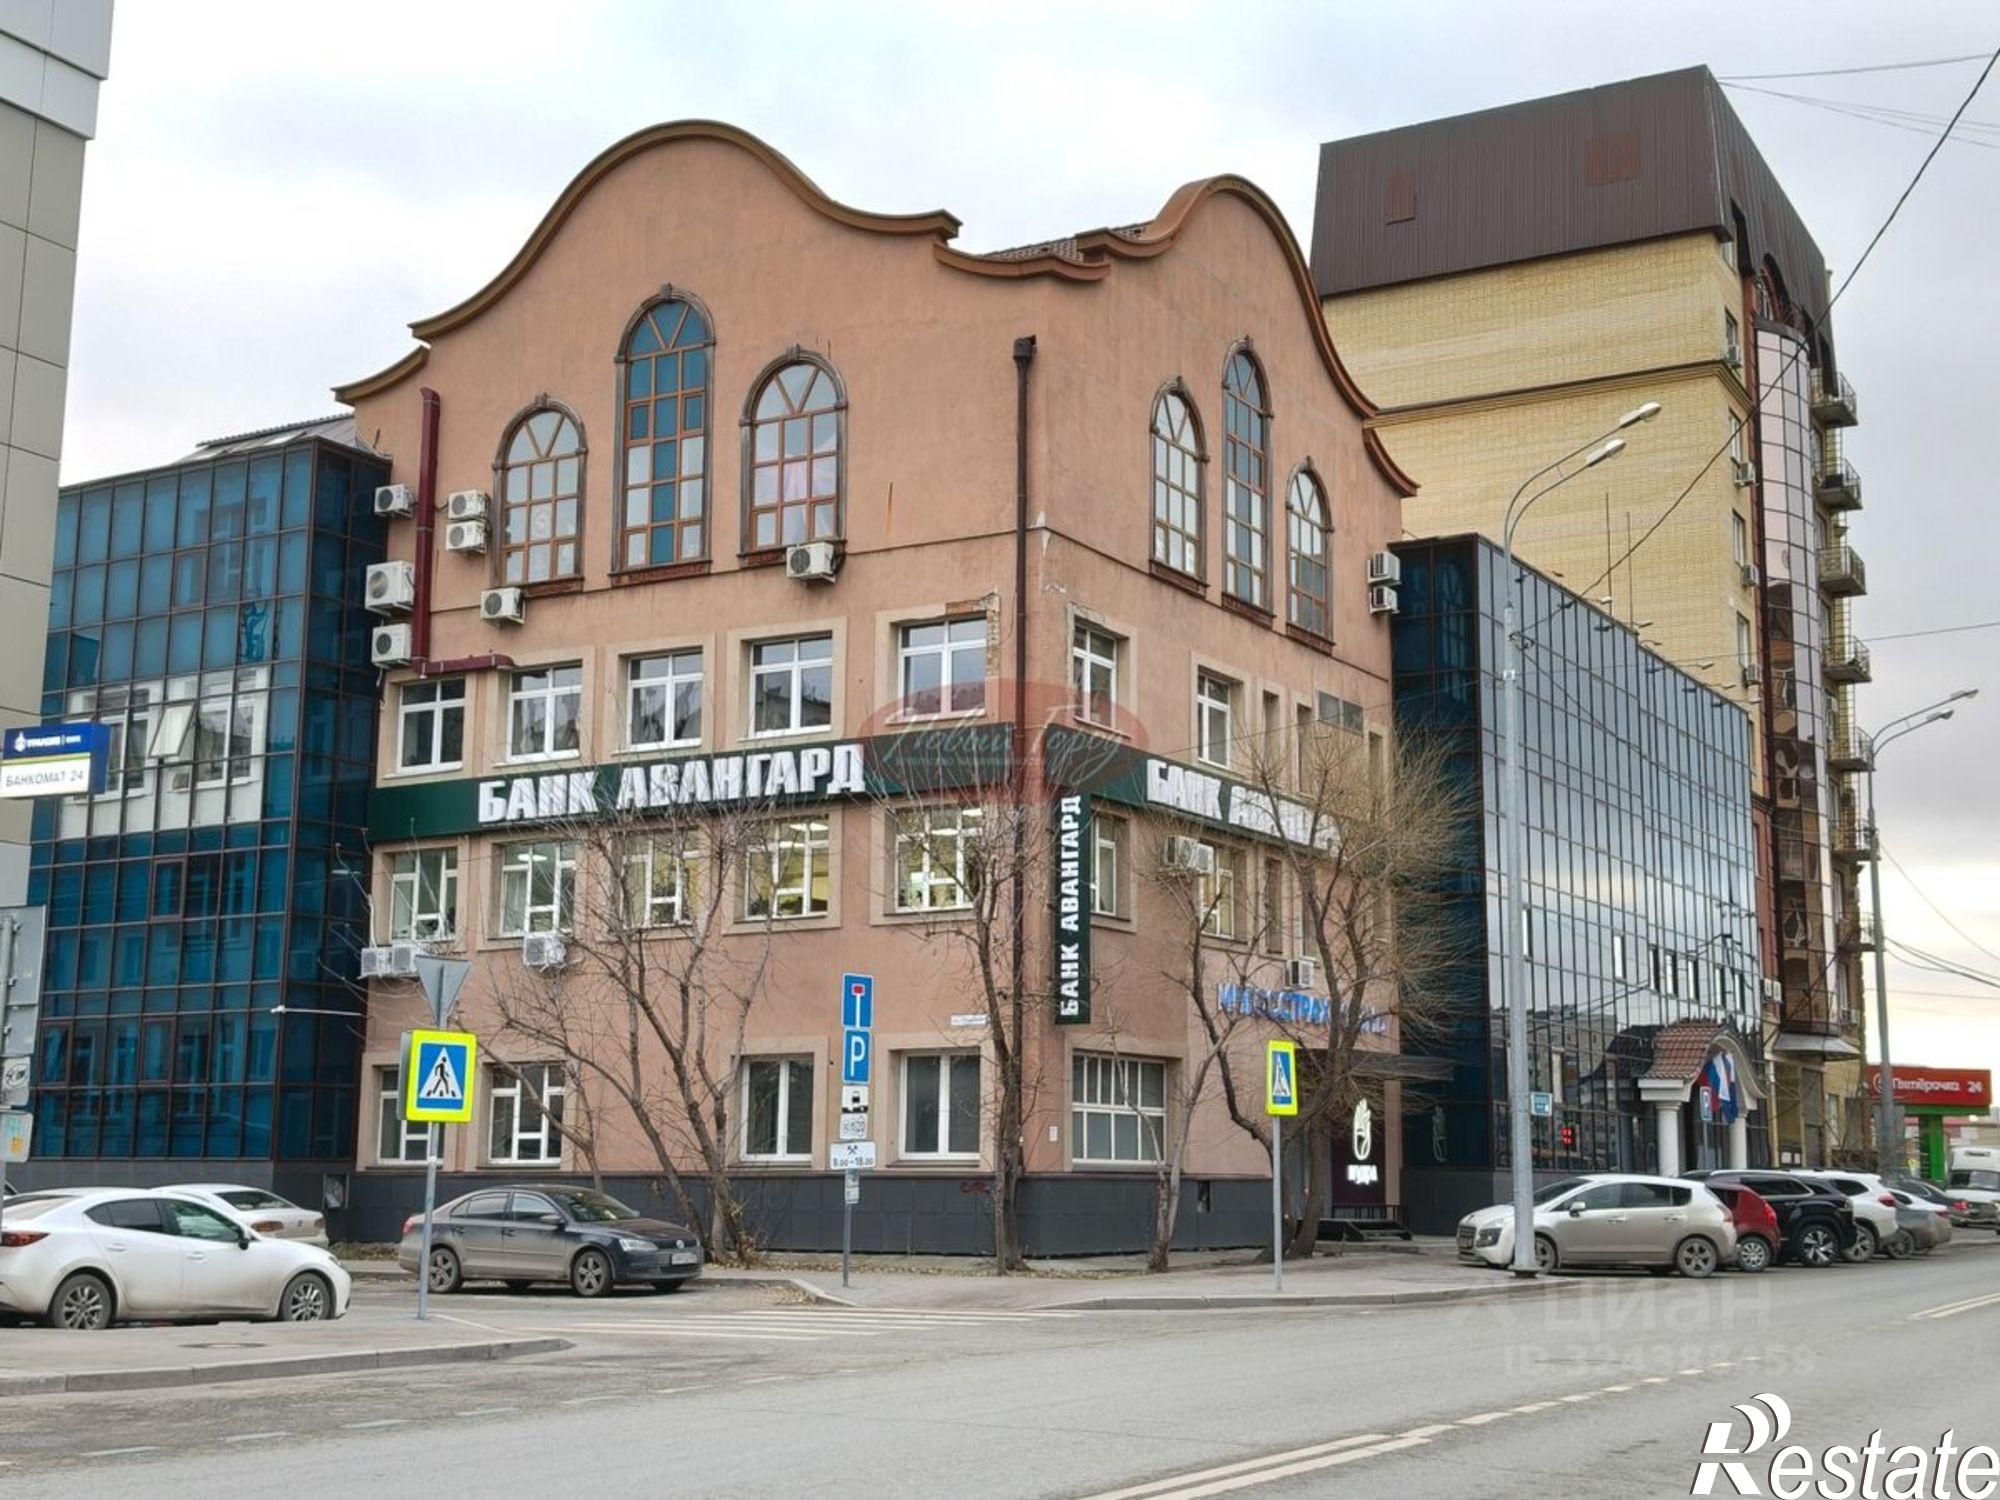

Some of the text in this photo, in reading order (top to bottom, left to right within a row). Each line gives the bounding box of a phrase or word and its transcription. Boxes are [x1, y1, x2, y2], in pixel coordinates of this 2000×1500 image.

[6, 769, 84, 787] БАНКОМАТ 24
[478, 743, 867, 824] БАНК АВАНГАРД
[1147, 759, 1222, 821] БАНК
[1060, 795, 1082, 1016] БАНК АВАНГАРД
[1967, 1080, 1982, 1094] 24
